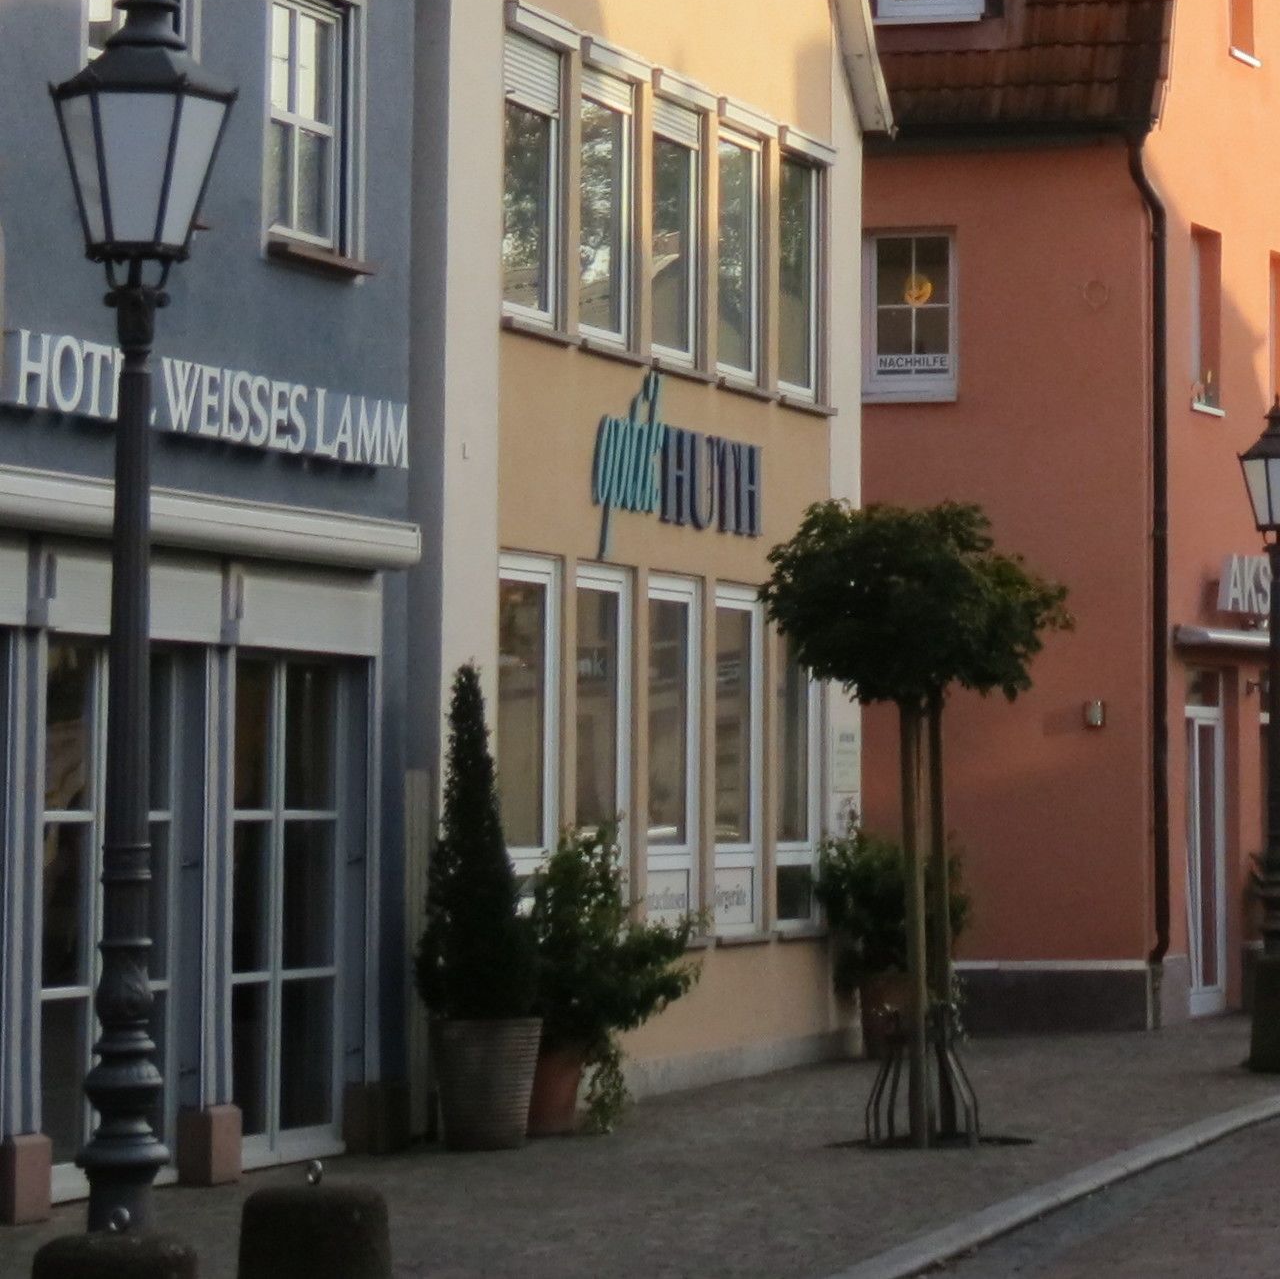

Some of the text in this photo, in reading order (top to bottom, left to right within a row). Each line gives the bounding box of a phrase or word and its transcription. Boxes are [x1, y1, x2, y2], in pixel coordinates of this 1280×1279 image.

[16, 328, 410, 470] HOT WEISSES LAMM
[879, 356, 947, 368] NACHHILFE
[659, 423, 763, 541] HUTH
